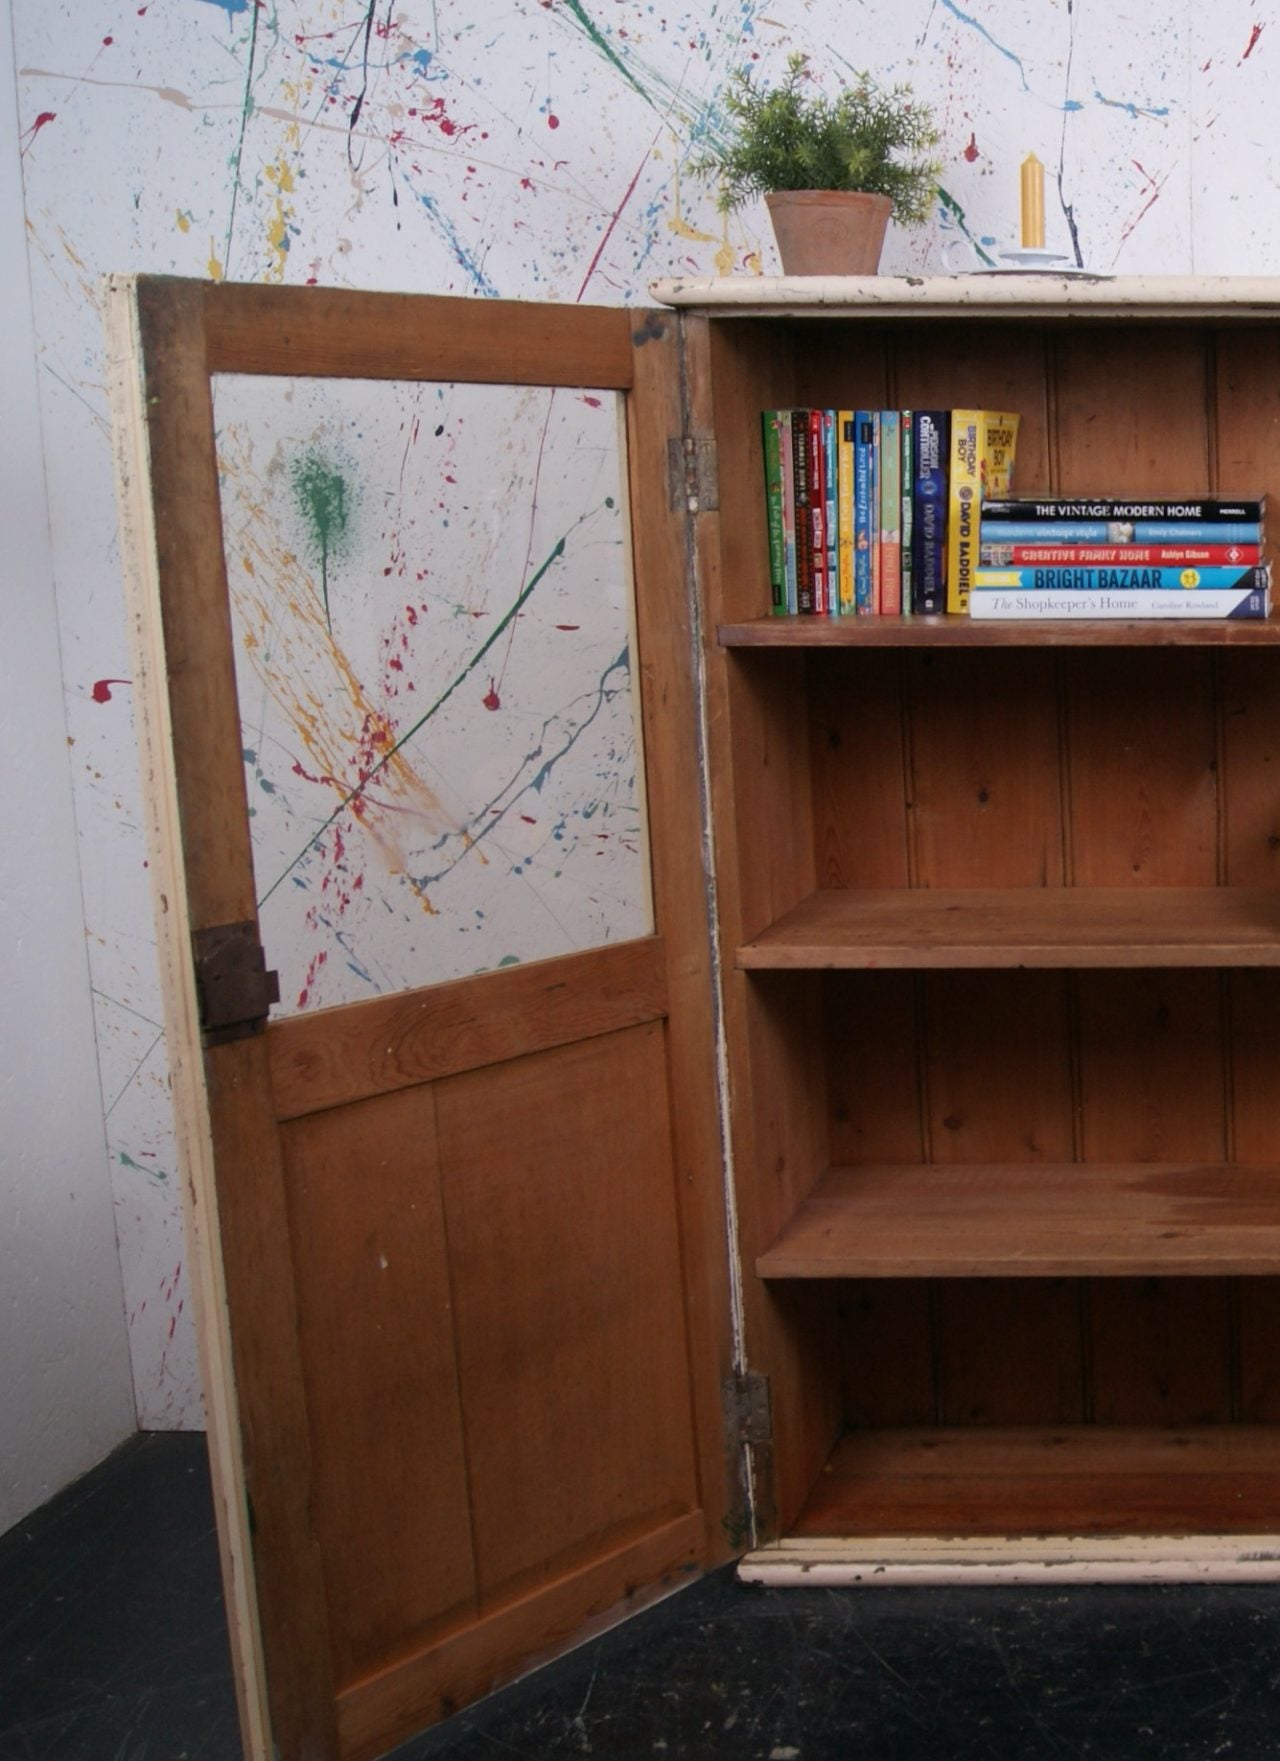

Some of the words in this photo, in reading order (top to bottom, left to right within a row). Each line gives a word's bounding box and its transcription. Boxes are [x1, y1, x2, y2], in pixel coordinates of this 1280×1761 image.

[957, 439, 968, 464] BOY
[965, 426, 977, 478] BIRTHDAY
[959, 502, 972, 537] DAVID
[1035, 505, 1057, 516] THE
[1058, 505, 1111, 516] VINTAGE
[1113, 505, 1166, 517] MODERN
[1167, 505, 1203, 517] HOME
[1037, 526, 1074, 538] vintage
[1021, 550, 1076, 561] CREATIVE
[1119, 549, 1151, 561] HOME
[1161, 550, 1184, 561] Ashlyn
[1185, 550, 1210, 560] Gibson
[958, 542, 972, 596] BADDIEL
[1034, 569, 1095, 589] BRIGHT
[1097, 569, 1163, 589] BAZAAR
[992, 597, 1013, 610] The
[1016, 597, 1097, 612] Shopkeeper's
[1100, 596, 1139, 609] Home
